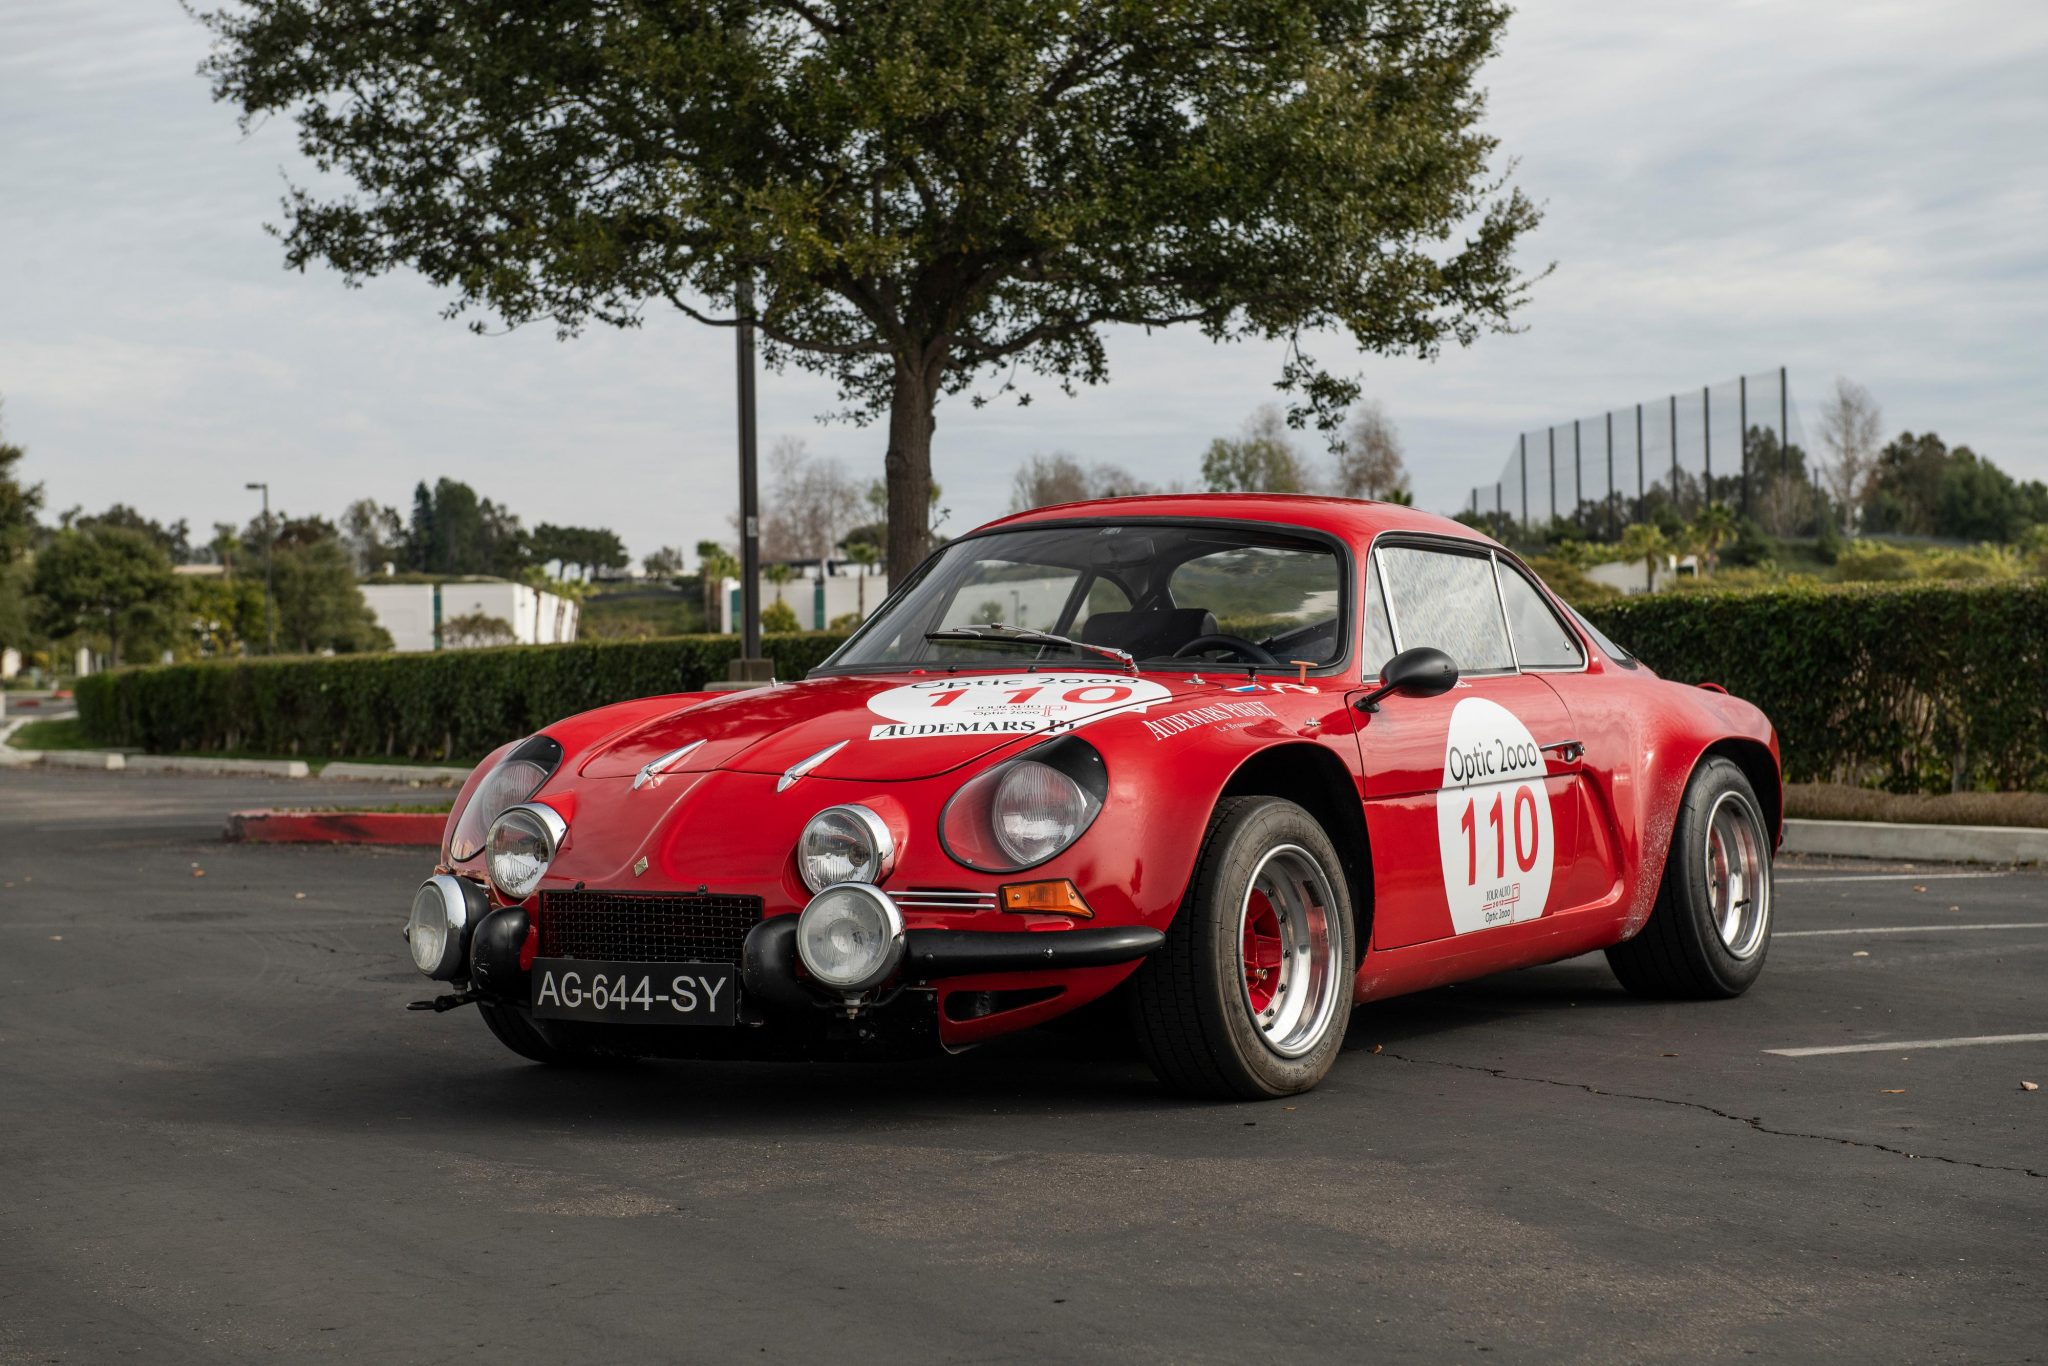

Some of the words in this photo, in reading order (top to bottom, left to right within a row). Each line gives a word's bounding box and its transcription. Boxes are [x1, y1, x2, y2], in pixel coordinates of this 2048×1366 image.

[911, 679, 1023, 689] Optic
[1039, 677, 1139, 685] 2000
[928, 686, 1133, 708] 110
[874, 720, 1036, 737] AUDEMARS
[1141, 706, 1232, 741] AUDEMARS
[1216, 701, 1278, 718] PIGUET
[1449, 742, 1495, 791] Optic
[1495, 738, 1537, 772] 2000
[1461, 785, 1539, 886] 110
[537, 971, 727, 1013] AG-644-SY
